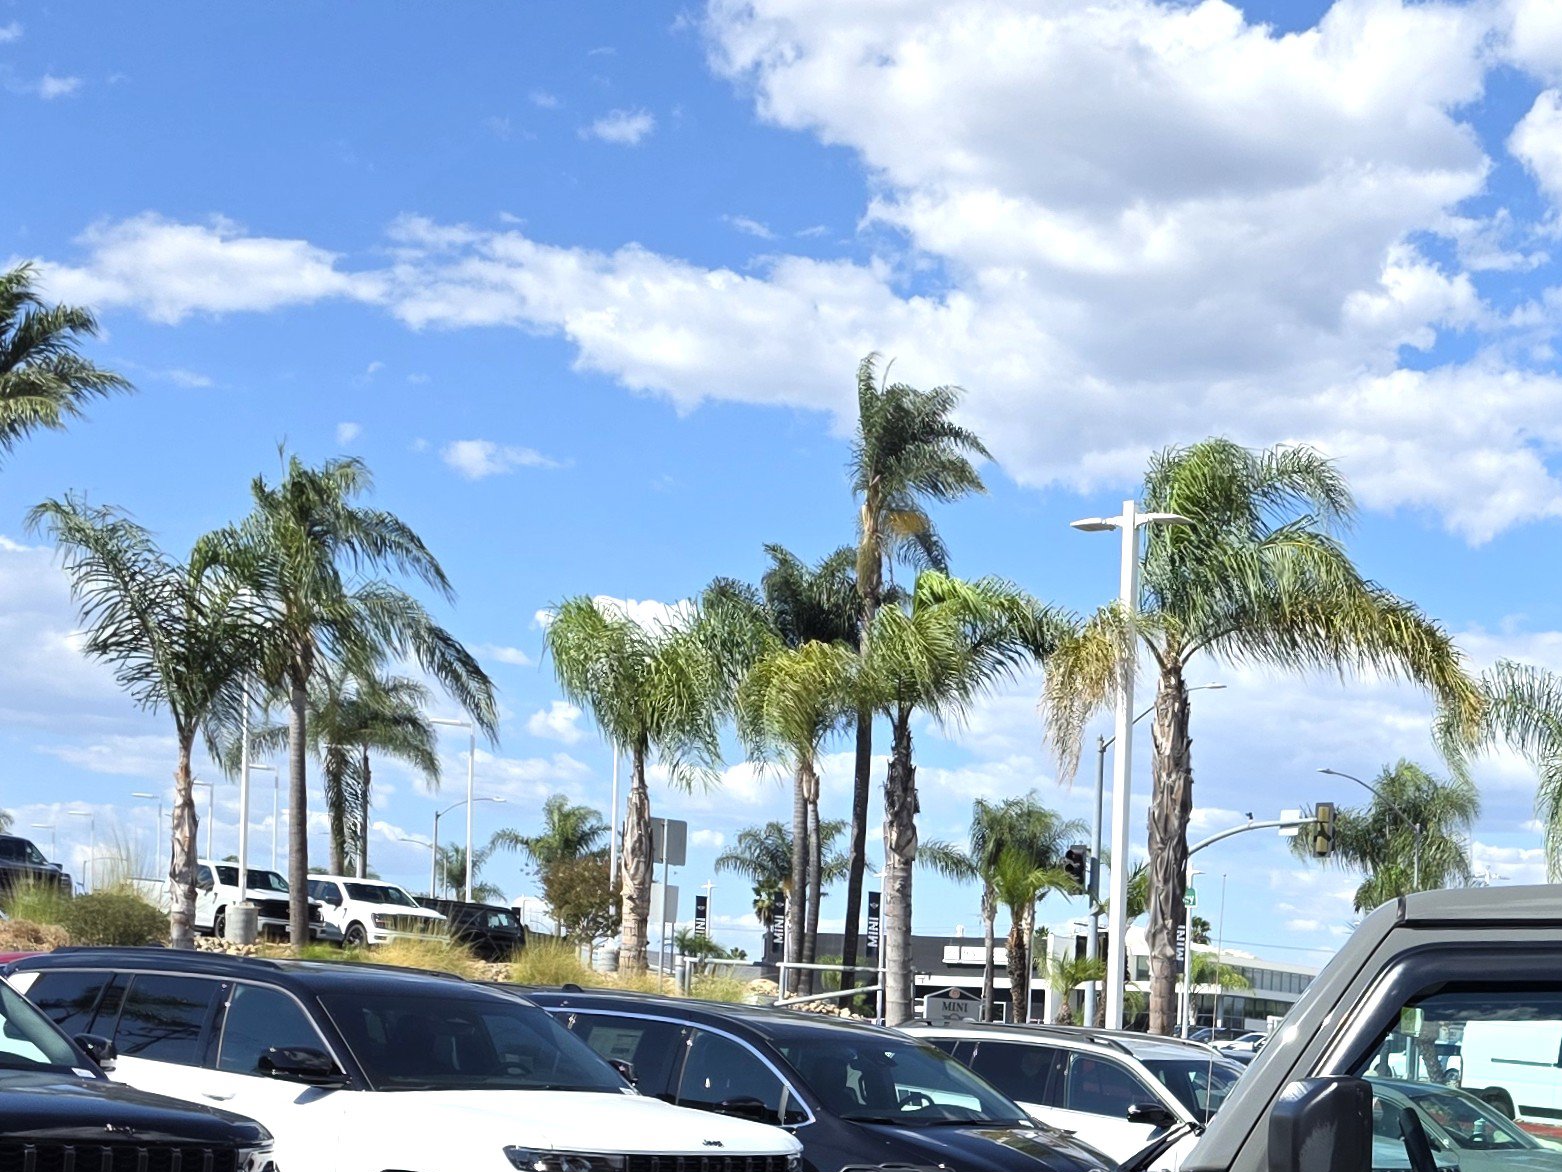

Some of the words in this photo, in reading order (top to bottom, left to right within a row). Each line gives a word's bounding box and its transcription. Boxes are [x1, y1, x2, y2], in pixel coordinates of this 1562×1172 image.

[695, 917, 706, 934] INI
[773, 915, 785, 944] MINI
[867, 916, 879, 948] MINI
[1175, 924, 1186, 962] MINI
[942, 1001, 968, 1013] MINI
